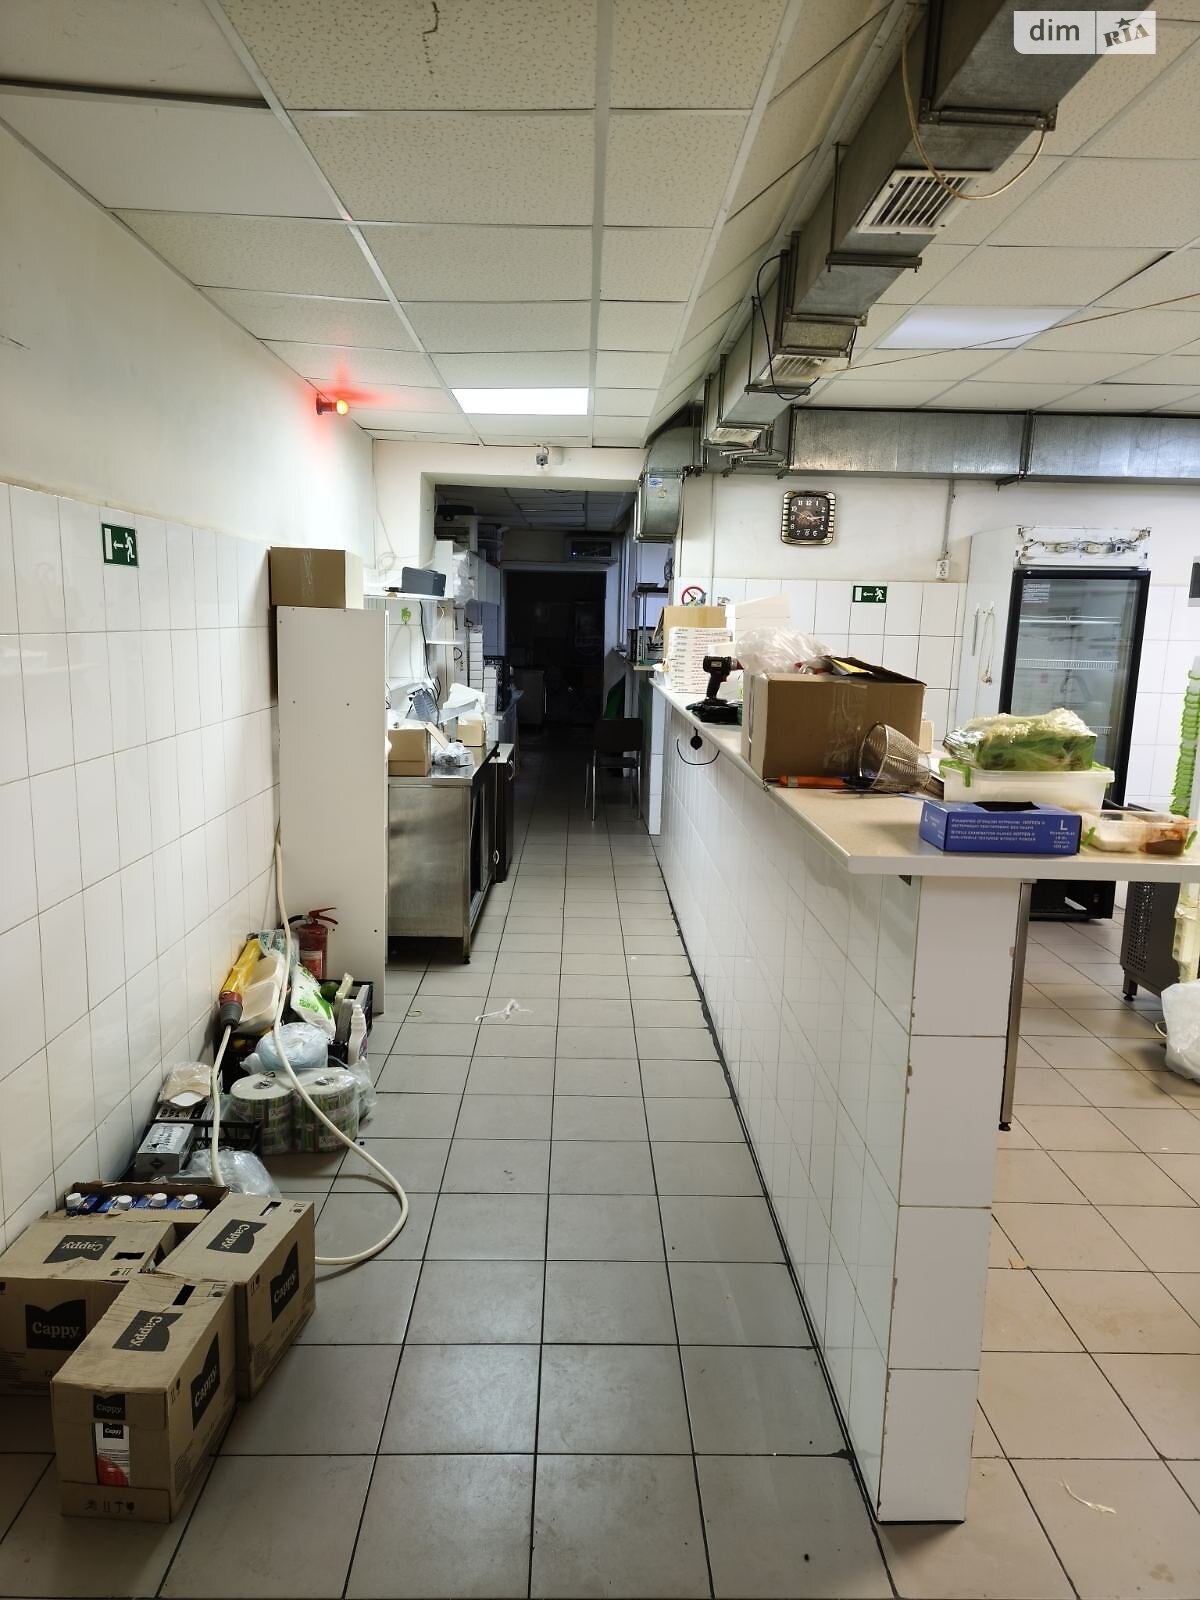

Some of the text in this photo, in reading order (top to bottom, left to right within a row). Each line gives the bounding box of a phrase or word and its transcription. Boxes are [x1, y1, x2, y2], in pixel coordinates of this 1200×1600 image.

[1060, 819, 1068, 831] L
[61, 1241, 104, 1252] Cappy
[221, 1224, 250, 1249] Cappy
[273, 1273, 296, 1304] Cappy
[32, 1321, 80, 1339] Cappy
[130, 1315, 163, 1347] Cappy
[194, 1367, 217, 1408] Cappy
[96, 1403, 122, 1417] Cappy
